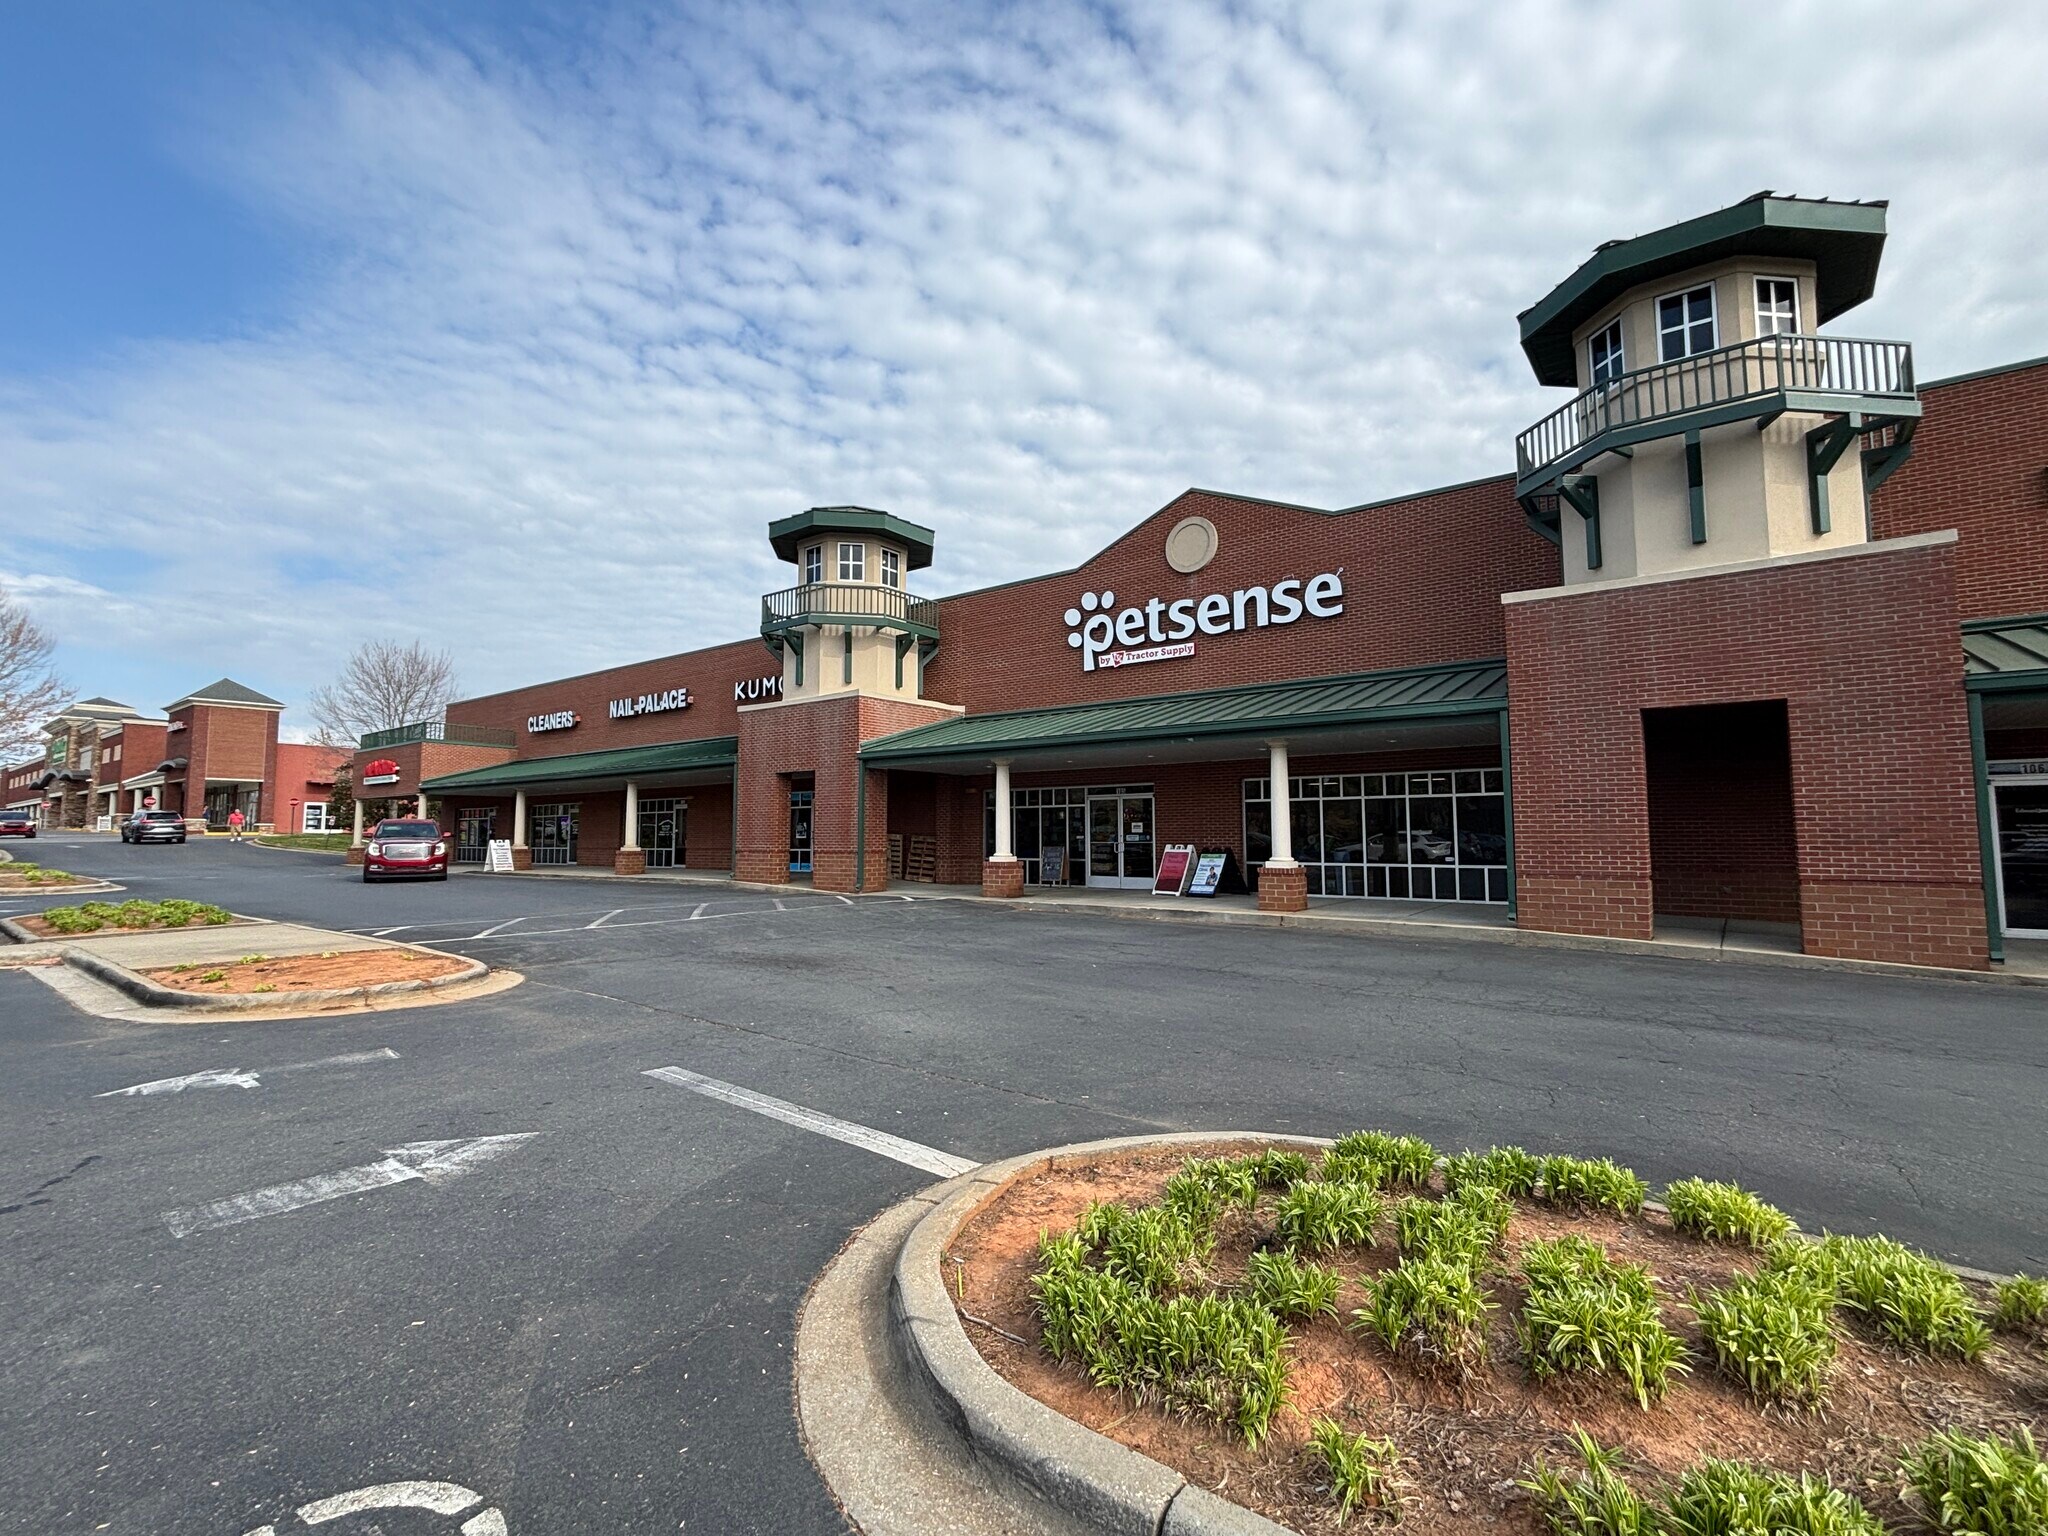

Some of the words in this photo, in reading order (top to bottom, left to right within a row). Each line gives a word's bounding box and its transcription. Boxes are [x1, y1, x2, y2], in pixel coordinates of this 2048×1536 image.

[1083, 573, 1343, 671] petsense
[1100, 656, 1111, 666] by
[1125, 650, 1159, 660] Tractor
[1161, 644, 1193, 656] Supply
[609, 697, 635, 718] NAIL
[638, 688, 687, 714] PALACE
[528, 710, 574, 732] CLEANERS
